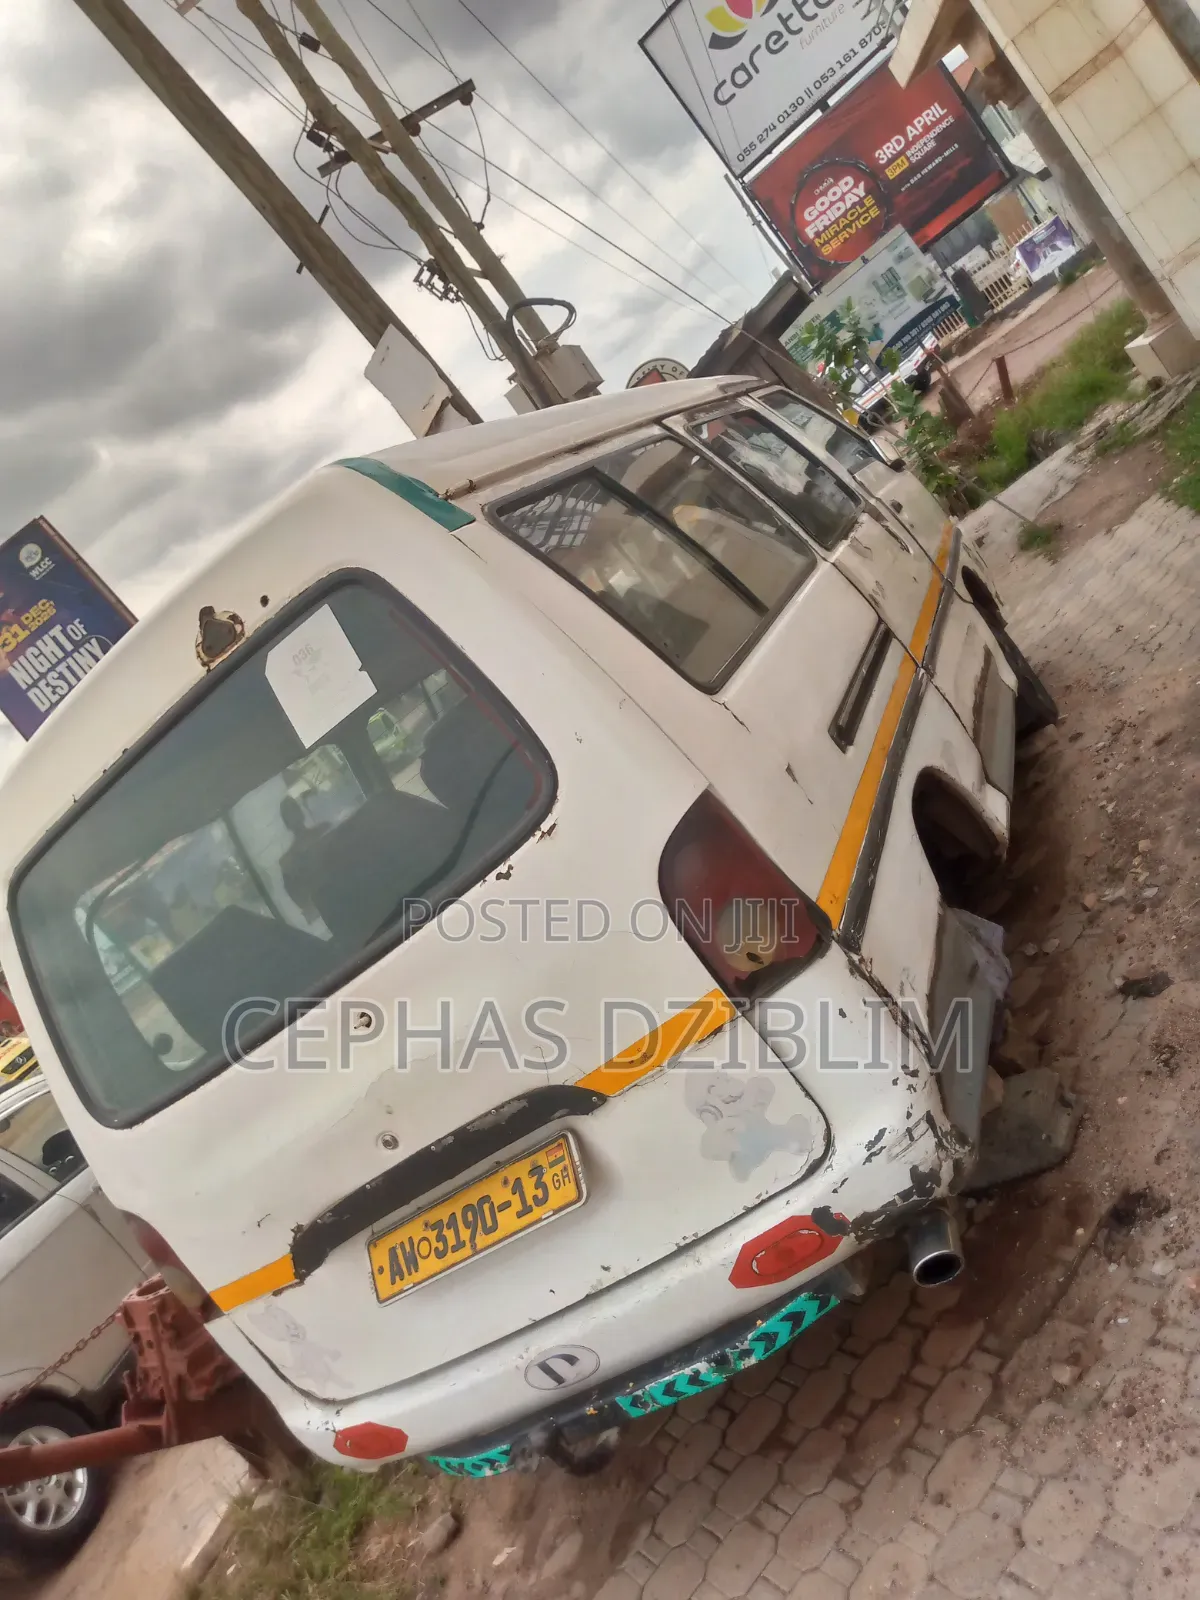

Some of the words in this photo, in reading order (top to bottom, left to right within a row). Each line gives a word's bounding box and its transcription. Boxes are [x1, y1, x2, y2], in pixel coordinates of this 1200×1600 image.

[800, 3, 845, 50] furniture
[736, 142, 757, 163] 055
[756, 123, 777, 146] 274
[776, 96, 805, 124] 0130
[813, 67, 837, 91] 053
[837, 47, 859, 70] 161
[875, 135, 906, 164] 3RD
[905, 102, 948, 141] APRIL
[905, 115, 955, 158] INDEPENDENCE
[909, 140, 937, 163] SQUARE
[887, 158, 906, 177] 3PM
[803, 175, 854, 221] GOOD
[804, 181, 866, 239] FRIDAY
[813, 195, 875, 247] MIRACLE
[821, 205, 880, 255] SERVICE
[29, 557, 53, 579] WLCC
[0, 623, 31, 653] 31
[8, 624, 74, 690] NIGHT
[66, 618, 88, 641] OF
[27, 637, 106, 713] DESTINY
[552, 1170, 572, 1191] GH
